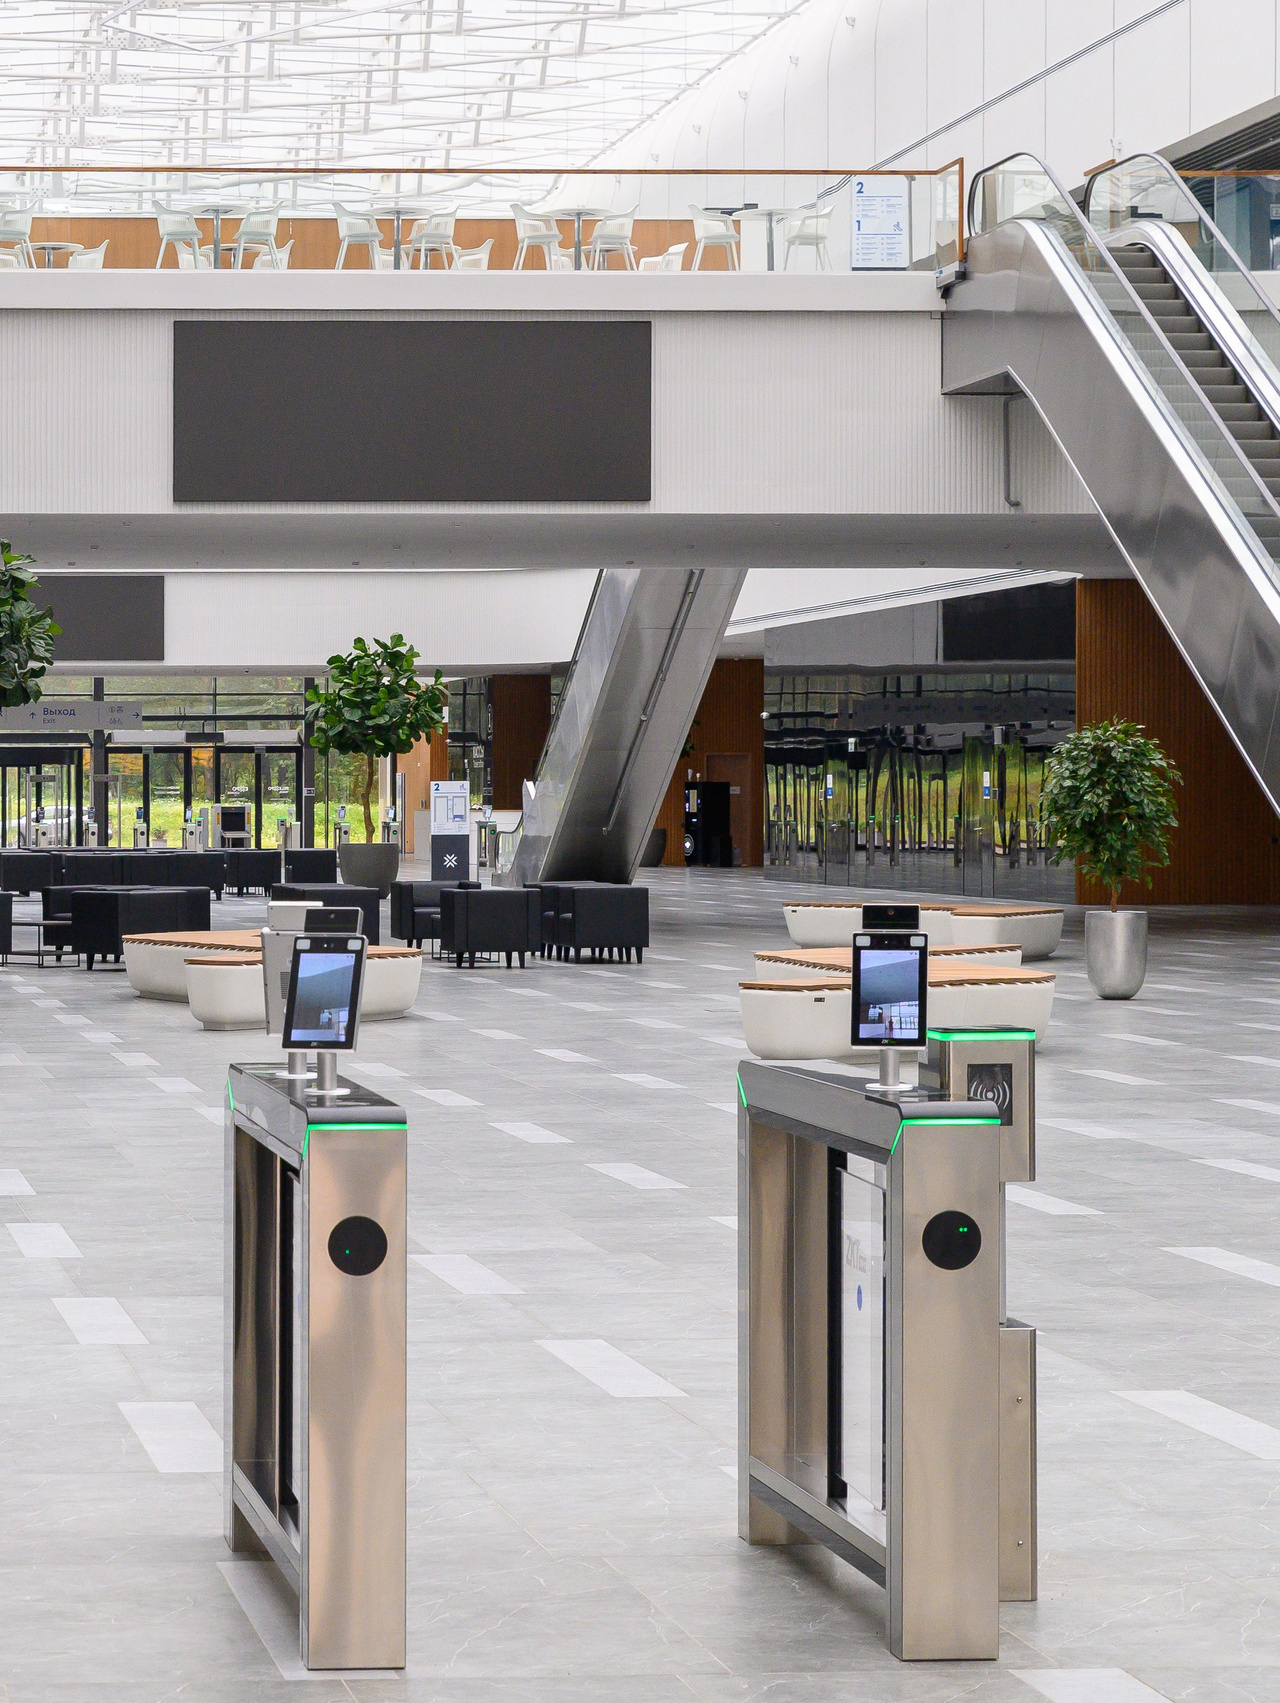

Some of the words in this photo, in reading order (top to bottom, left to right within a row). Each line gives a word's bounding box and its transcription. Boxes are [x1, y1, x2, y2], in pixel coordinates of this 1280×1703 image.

[856, 181, 864, 194] 2
[856, 220, 861, 232] 1
[42, 707, 76, 717] Выход
[42, 717, 56, 725] Exit
[433, 782, 440, 792] 2
